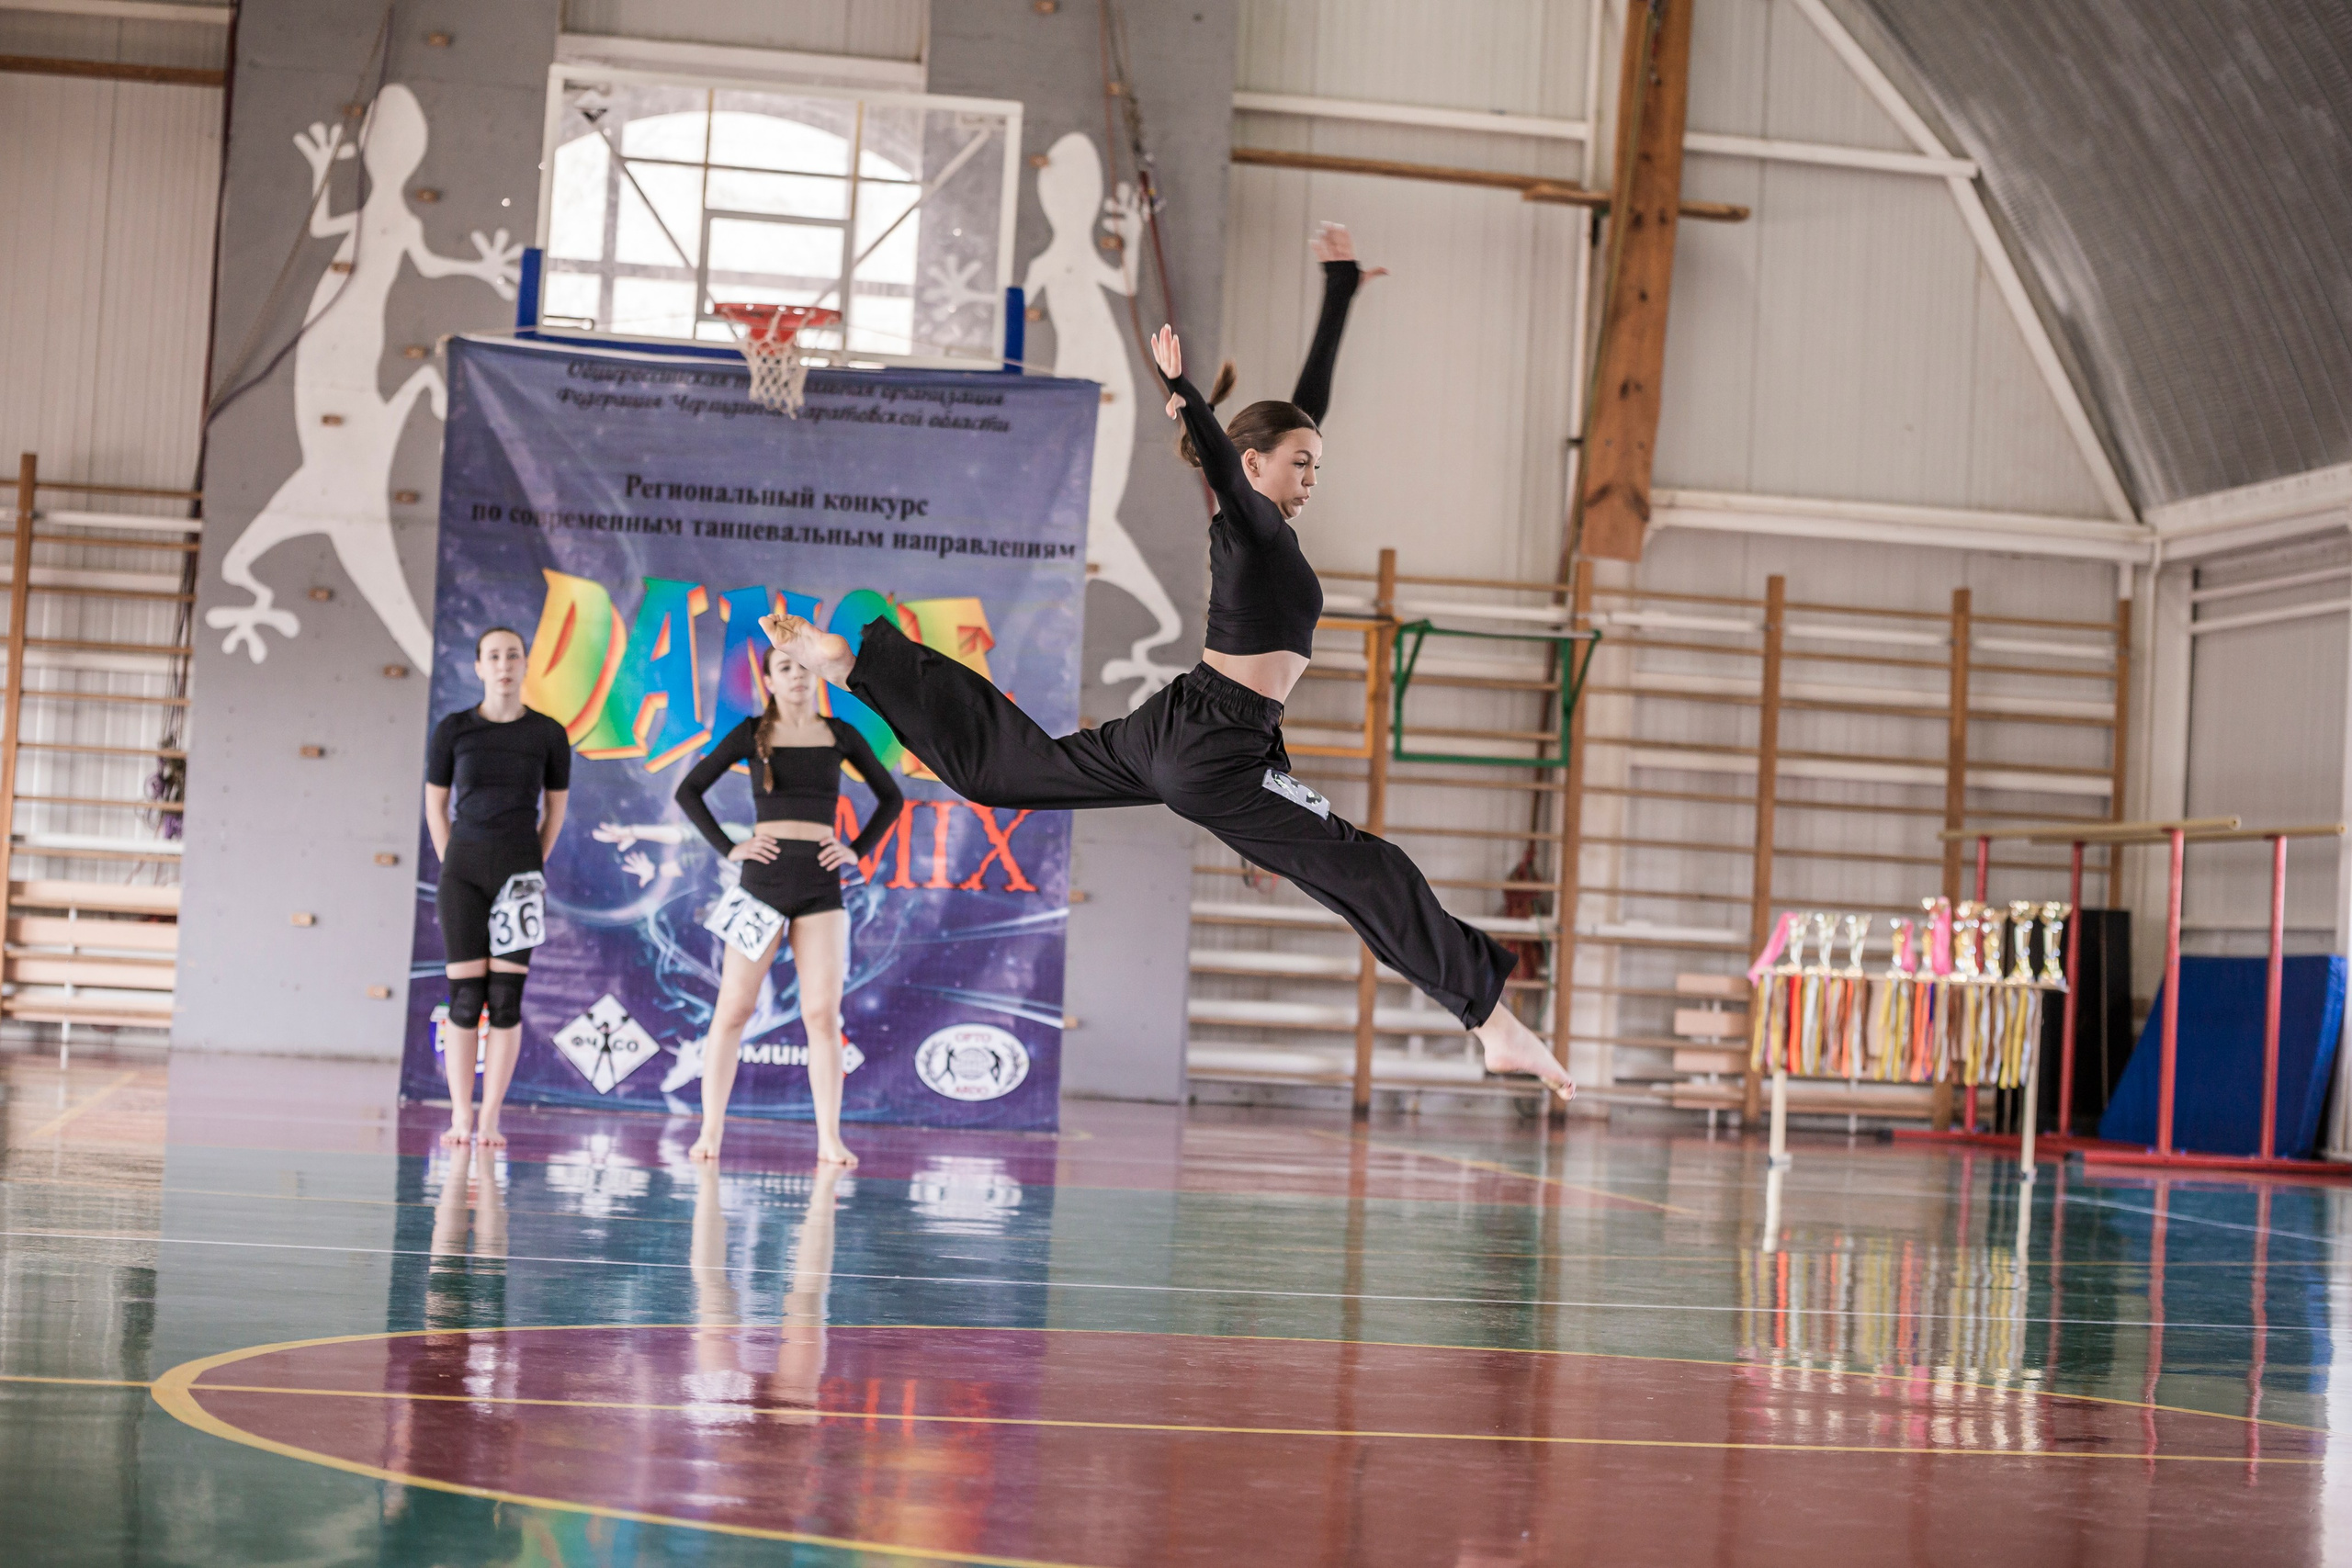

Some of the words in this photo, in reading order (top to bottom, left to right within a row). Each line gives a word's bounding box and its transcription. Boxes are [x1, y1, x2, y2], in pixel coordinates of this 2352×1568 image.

[626, 474, 815, 509] Региональный
[823, 492, 929, 521] конкурс
[471, 503, 502, 523] по
[508, 507, 683, 536] современным
[692, 519, 884, 548] танцевальным
[892, 528, 1075, 559] направлениям
[834, 794, 1039, 893] MIX
[490, 902, 540, 945] 36
